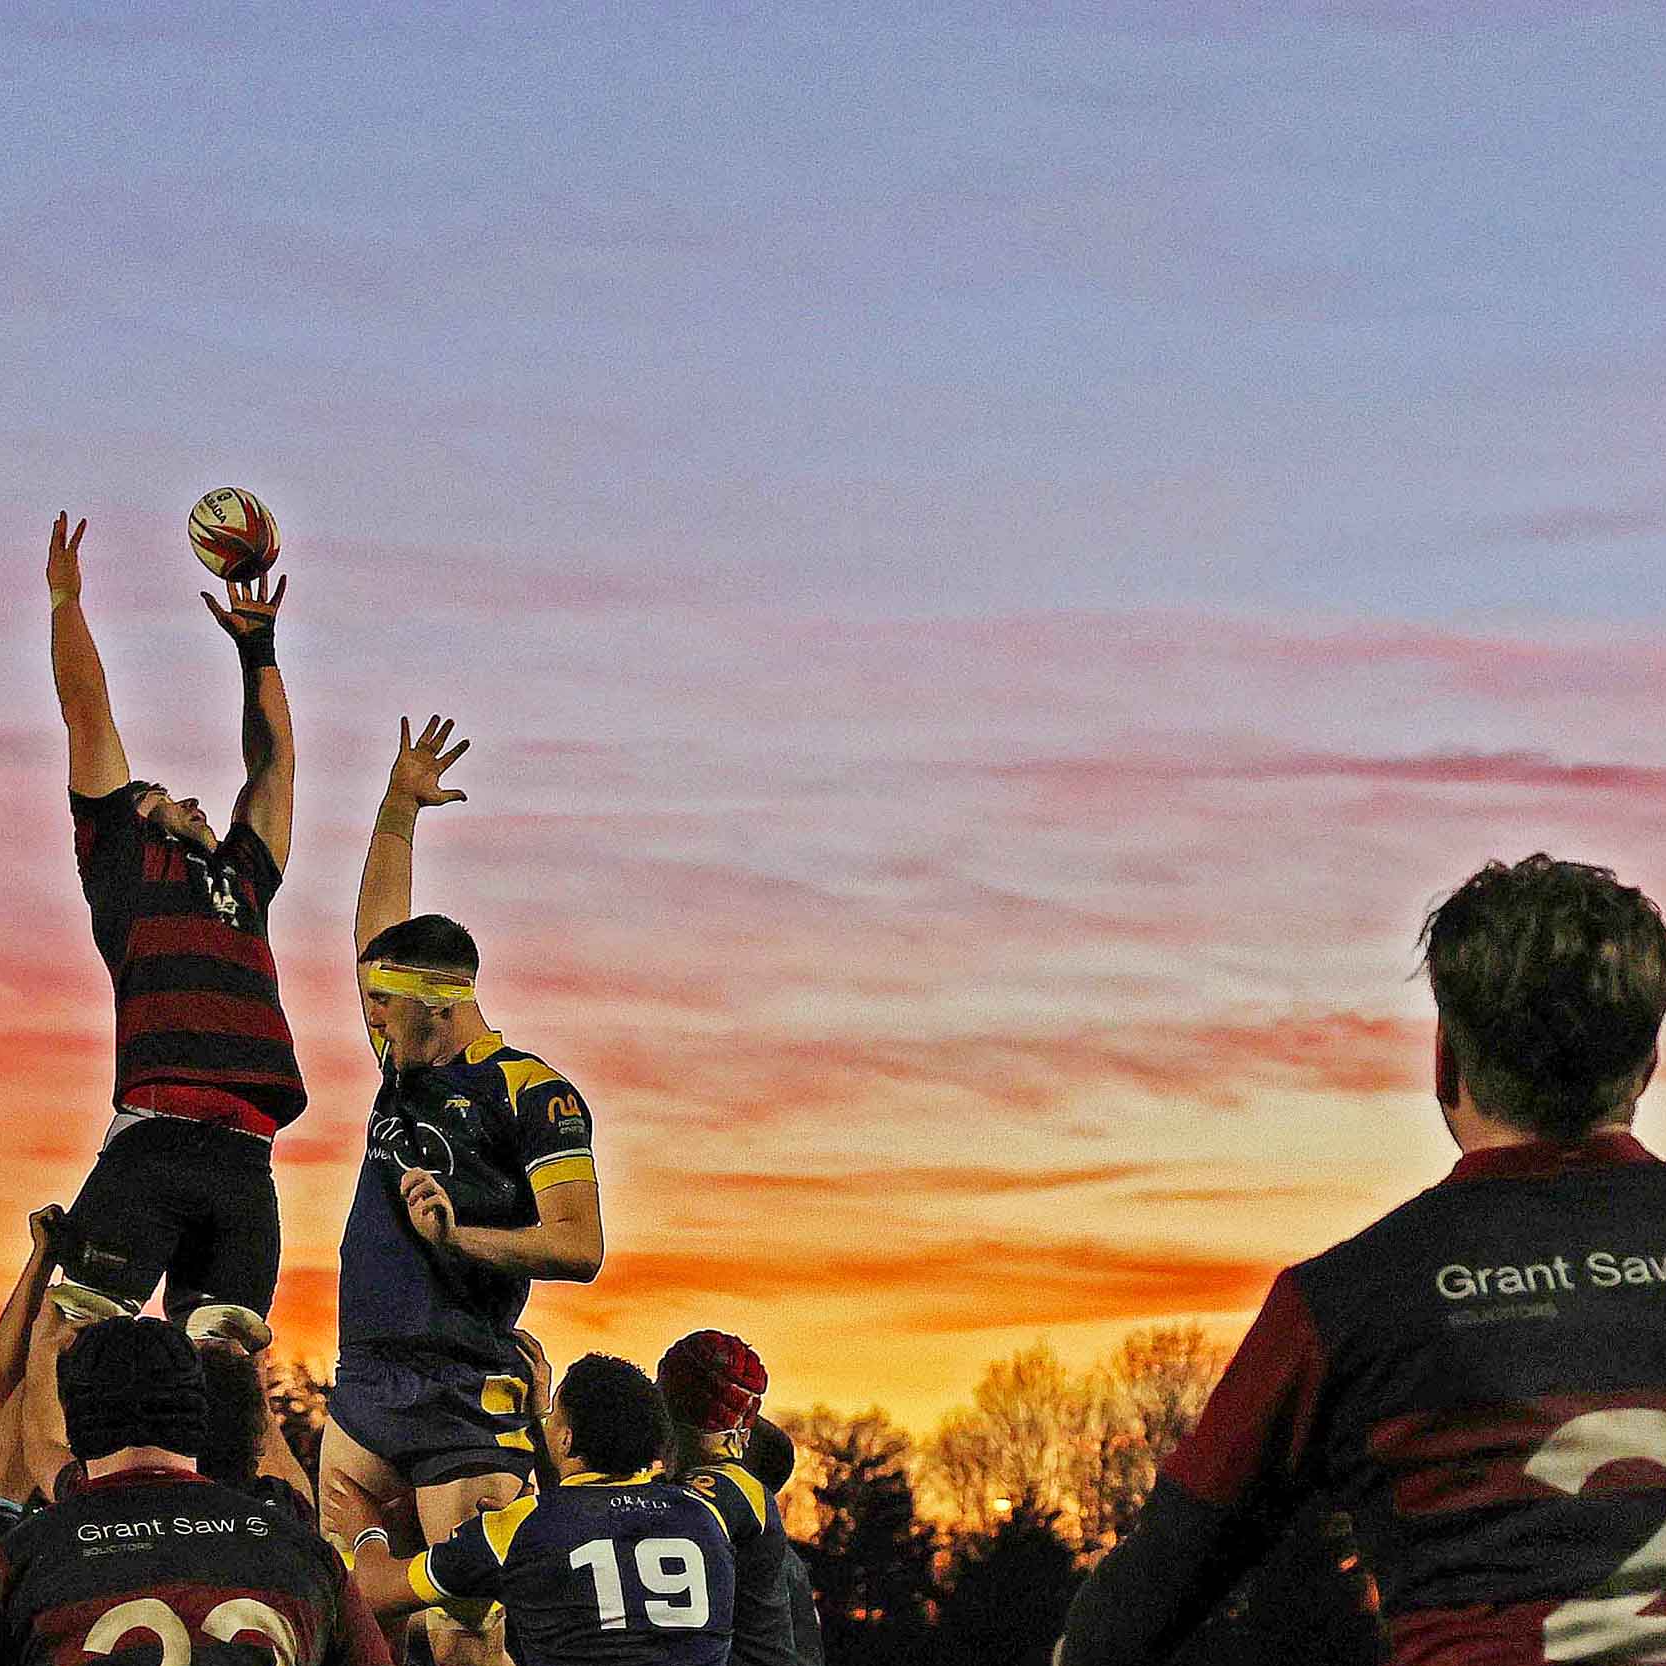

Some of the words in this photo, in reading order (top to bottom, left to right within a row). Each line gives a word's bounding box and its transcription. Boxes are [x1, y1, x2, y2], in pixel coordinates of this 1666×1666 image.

[1436, 1254, 1575, 1299] Grant
[77, 1519, 165, 1542] Grant
[172, 1516, 236, 1535] Saw
[569, 1537, 710, 1630] 19
